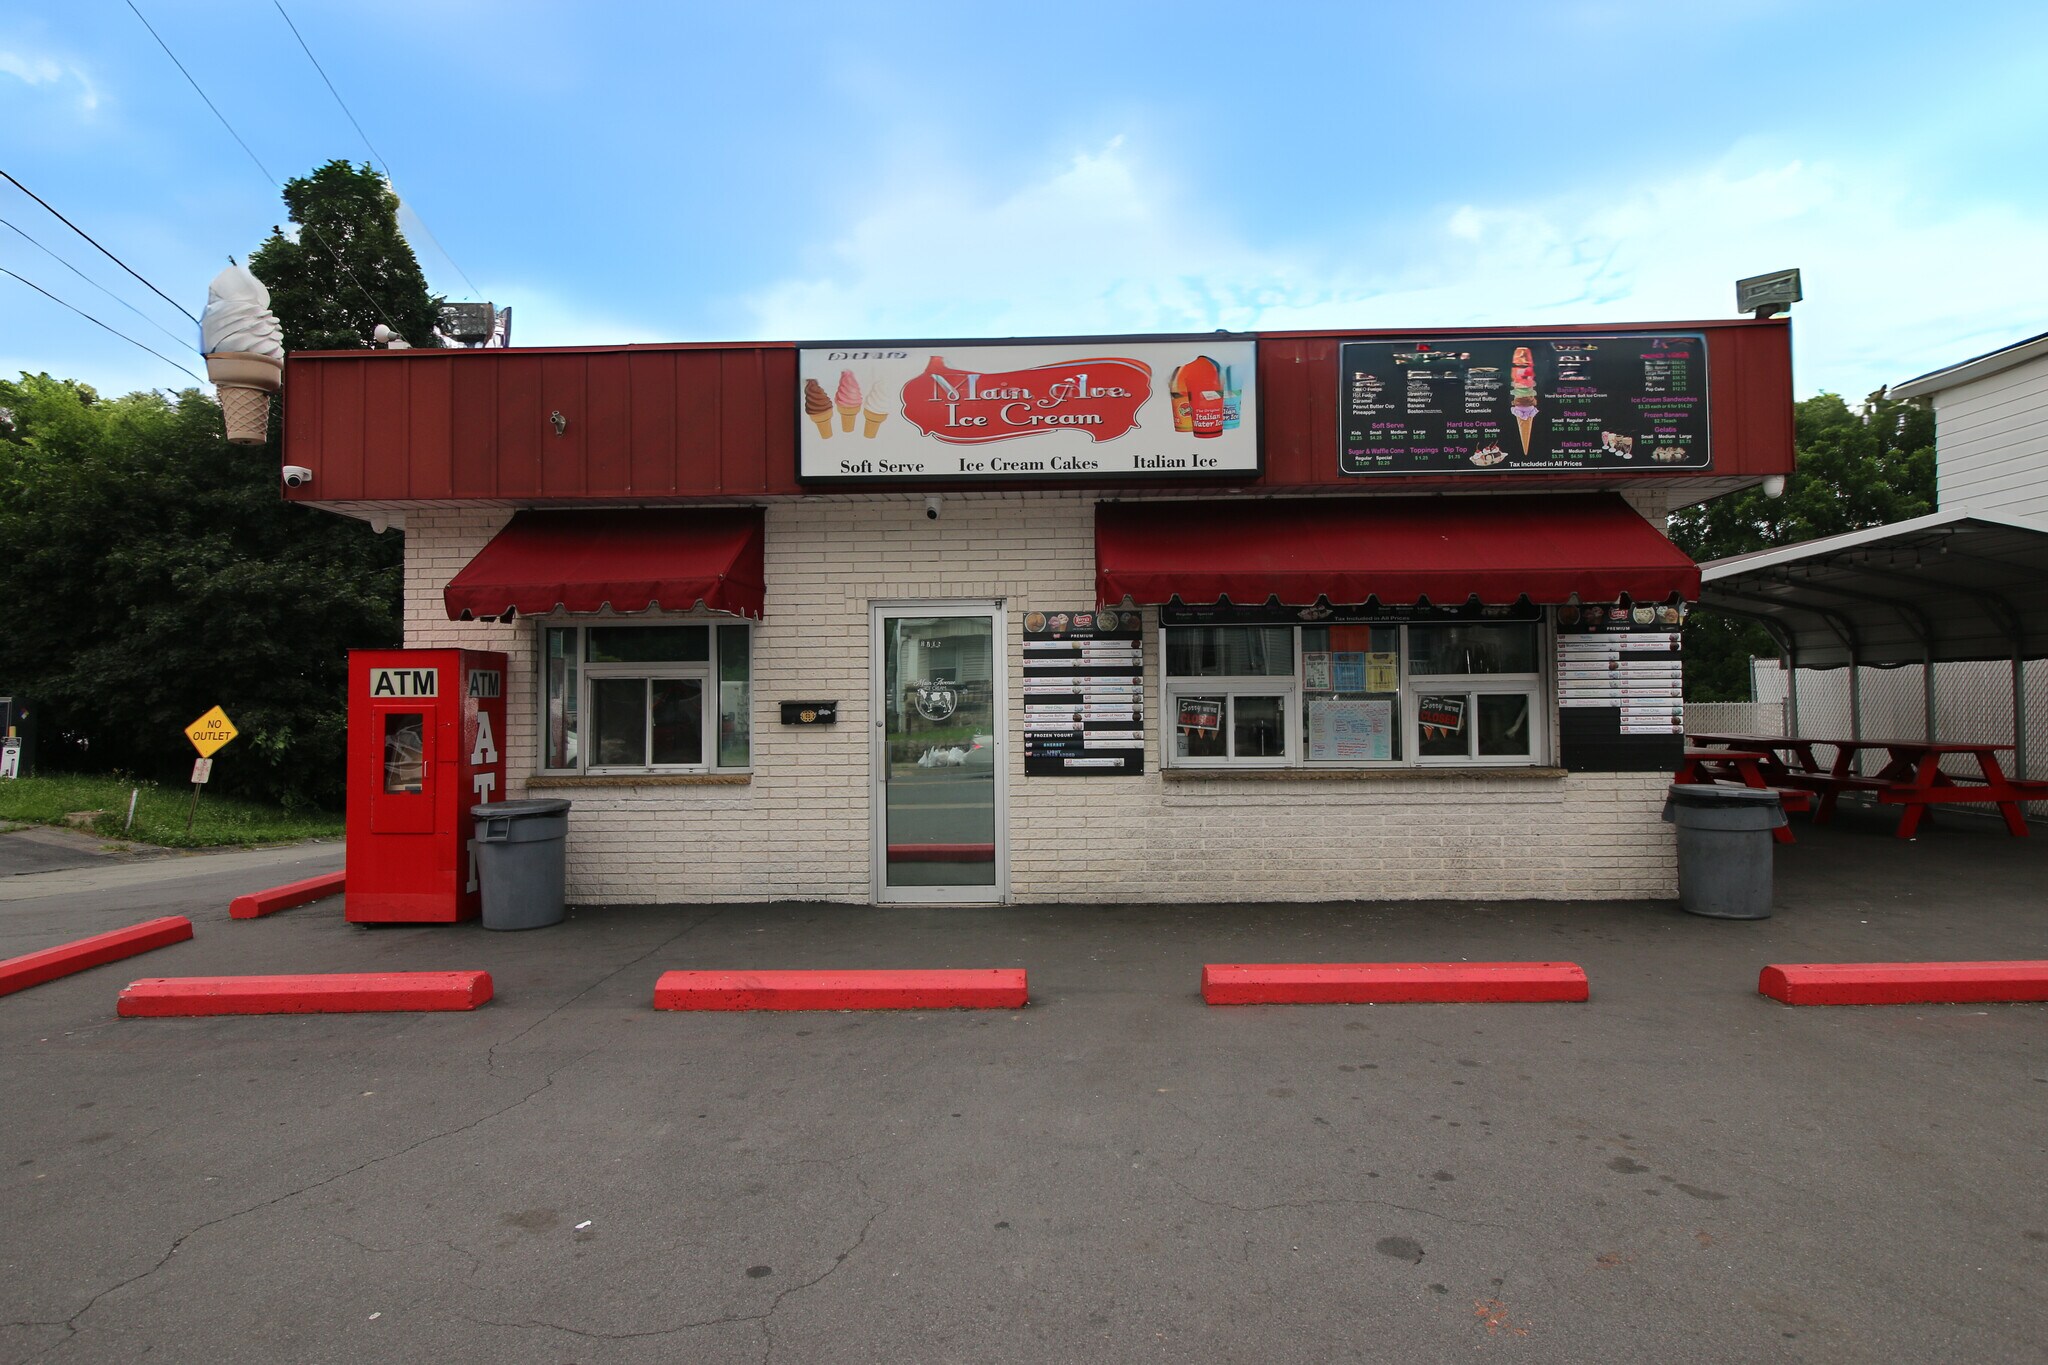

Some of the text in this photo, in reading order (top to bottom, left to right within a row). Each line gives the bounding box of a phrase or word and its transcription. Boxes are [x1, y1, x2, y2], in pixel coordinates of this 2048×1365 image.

[929, 373, 1031, 402] Main
[945, 403, 1102, 427] Ice Cream
[1196, 413, 1221, 421] Italian
[1193, 420, 1215, 428] Water
[840, 459, 924, 474] Soft Serve
[959, 456, 1099, 472] Ice Cream Cakes
[1133, 454, 1218, 470] Italian Ice
[375, 671, 435, 695] ATM
[469, 672, 499, 696] ATM
[1181, 702, 1201, 713] Sorry
[1422, 700, 1443, 711] Sorry
[207, 720, 222, 729] NO
[1181, 713, 1217, 726] CLOSED
[1420, 712, 1458, 725] CLOSED
[193, 731, 232, 741] OUTLET
